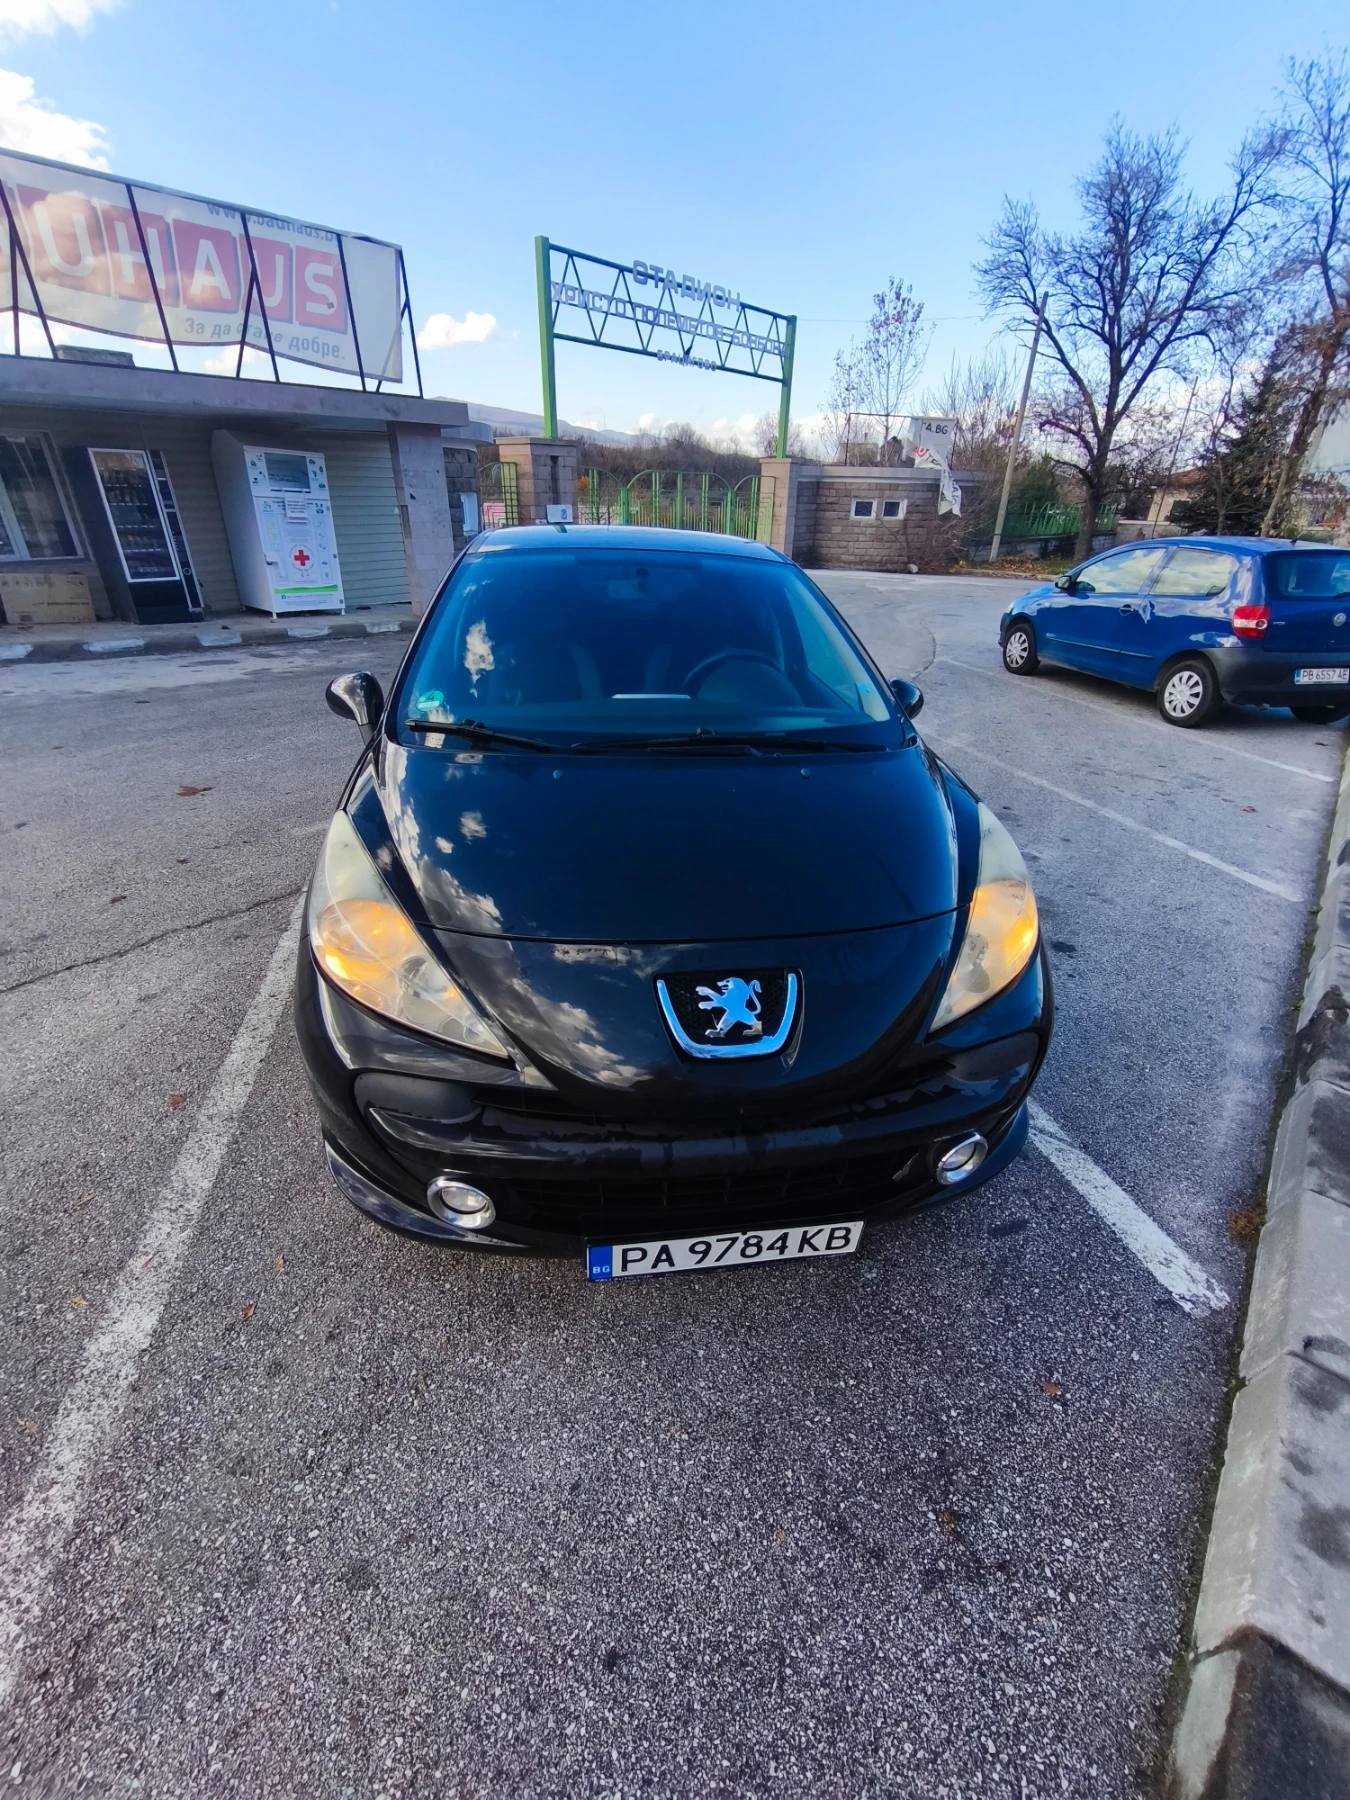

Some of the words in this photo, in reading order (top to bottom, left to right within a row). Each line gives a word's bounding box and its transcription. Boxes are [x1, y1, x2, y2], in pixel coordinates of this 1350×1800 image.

[551, 281, 627, 318] ХРИСТО
[632, 259, 741, 312] СТАДИОН
[184, 317, 205, 335] За
[211, 322, 231, 338] да
[288, 336, 346, 361] добре.
[657, 349, 717, 371] БРАЦИГОВО
[1316, 670, 1336, 680] 6557
[620, 1244, 676, 1273] PA
[688, 1231, 789, 1266] 9784
[797, 1226, 853, 1254] KB
[592, 1265, 611, 1275] BG
